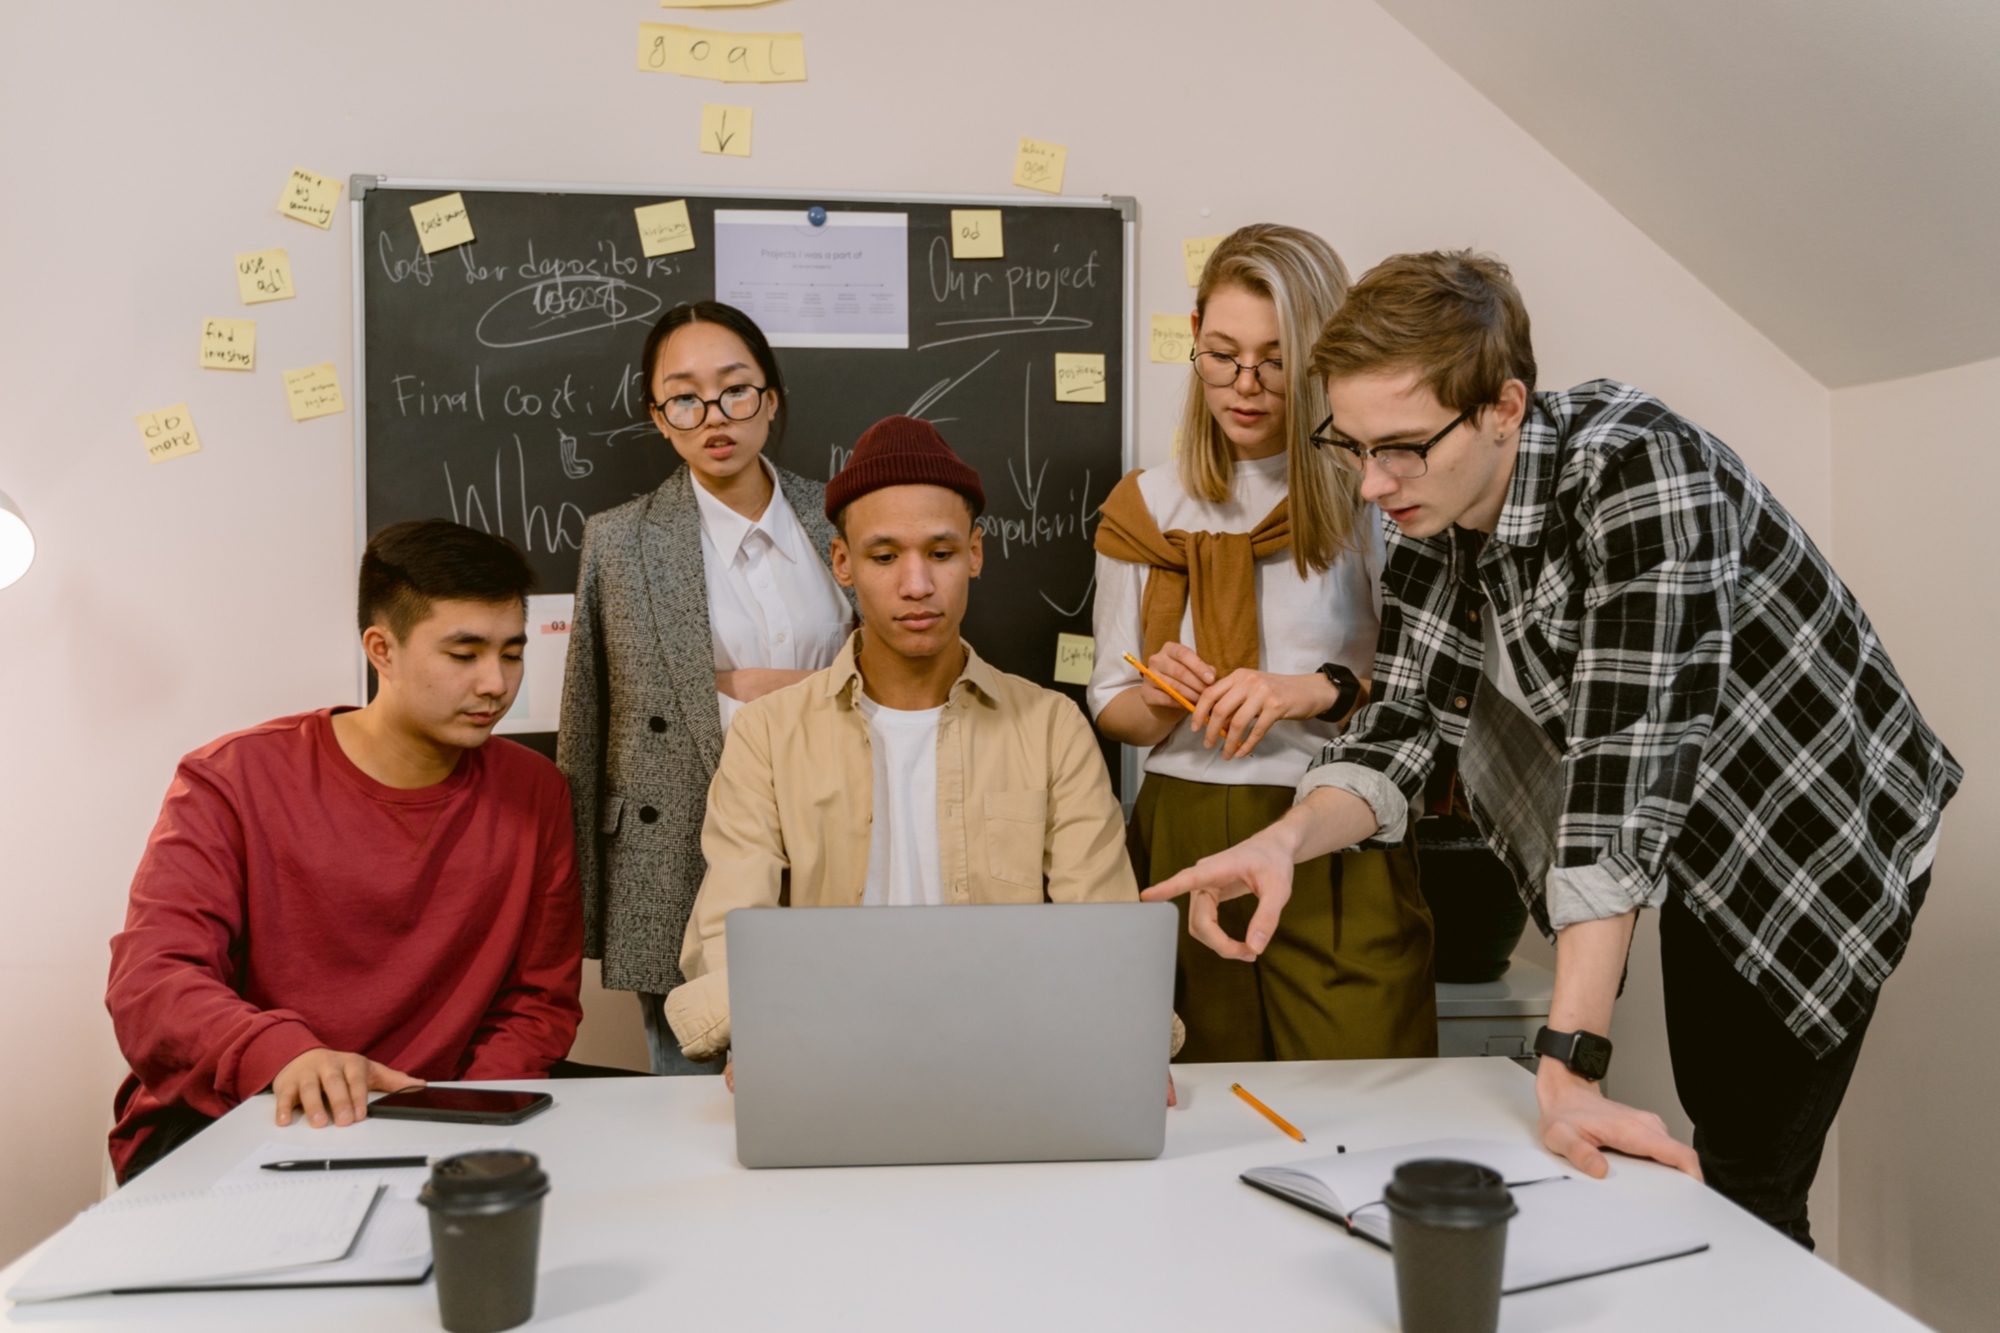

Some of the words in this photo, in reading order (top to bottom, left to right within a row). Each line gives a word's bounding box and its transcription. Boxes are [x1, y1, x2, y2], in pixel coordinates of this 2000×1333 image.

[648, 35, 786, 76] goal
[1021, 160, 1050, 181] goal
[760, 248, 797, 260] Projects
[804, 251, 823, 260] was
[824, 251, 832, 260] a
[832, 250, 852, 261] part
[853, 250, 863, 260] of
[928, 235, 994, 303] Our
[1004, 243, 1100, 326] project
[391, 365, 485, 422] Final
[144, 412, 181, 439] do
[149, 430, 195, 457] more
[551, 620, 567, 632] 03
